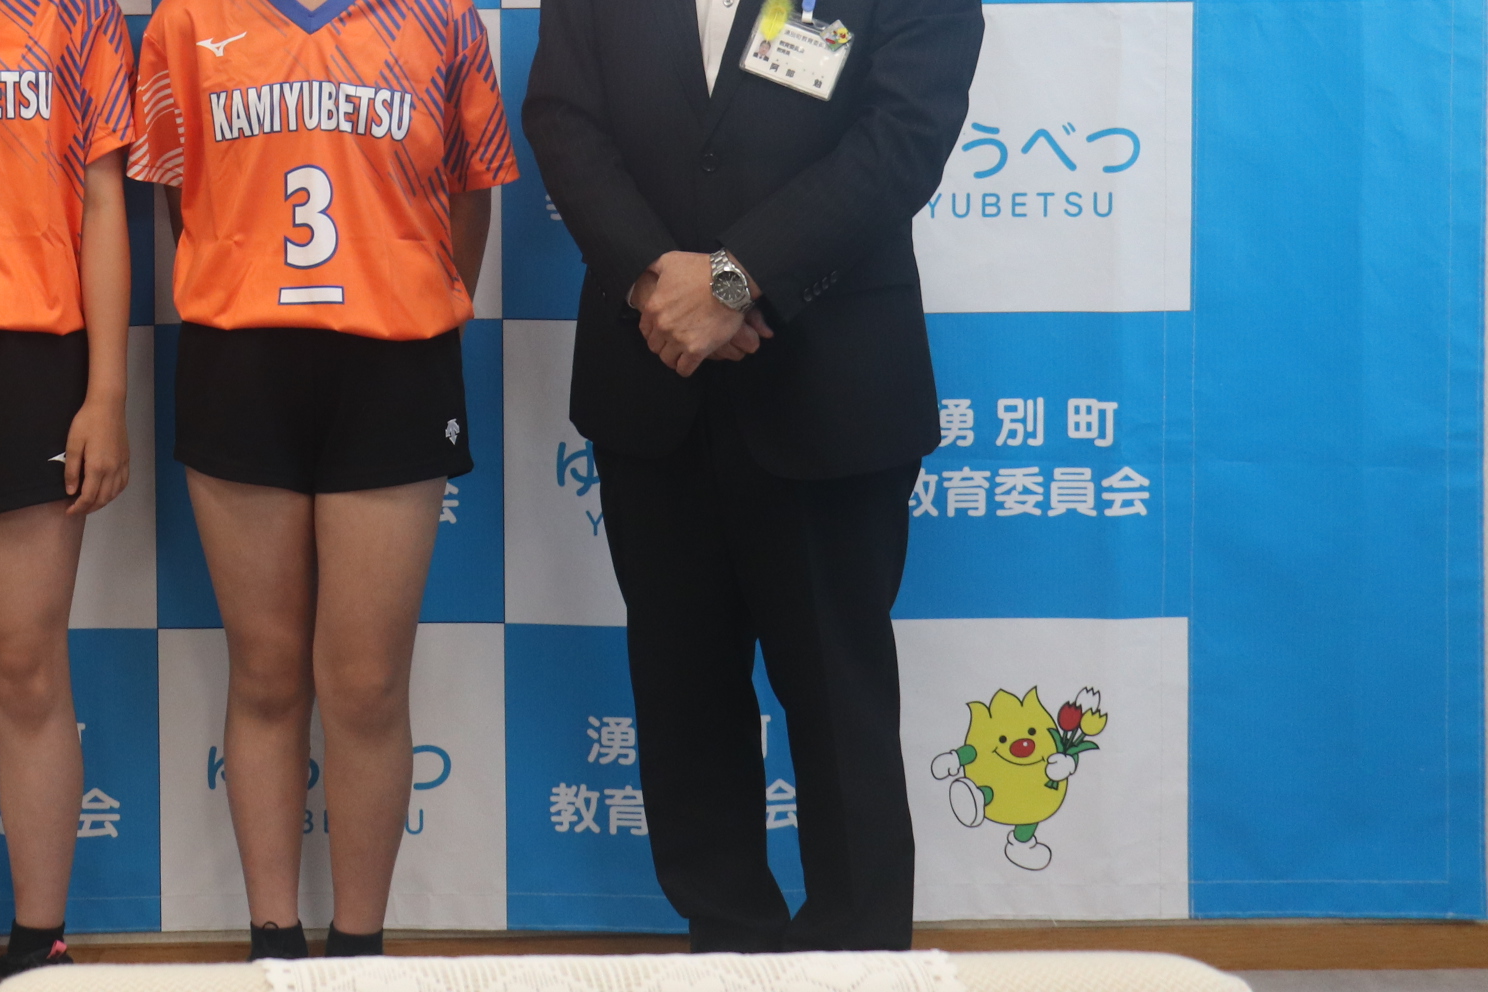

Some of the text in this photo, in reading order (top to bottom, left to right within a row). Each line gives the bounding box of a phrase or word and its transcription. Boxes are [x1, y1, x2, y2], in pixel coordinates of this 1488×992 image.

[208, 78, 413, 144] KAMIYUBETSU
[961, 121, 1142, 180] うべつ
[283, 164, 340, 269] 3
[925, 191, 1114, 220] YUBETSU
